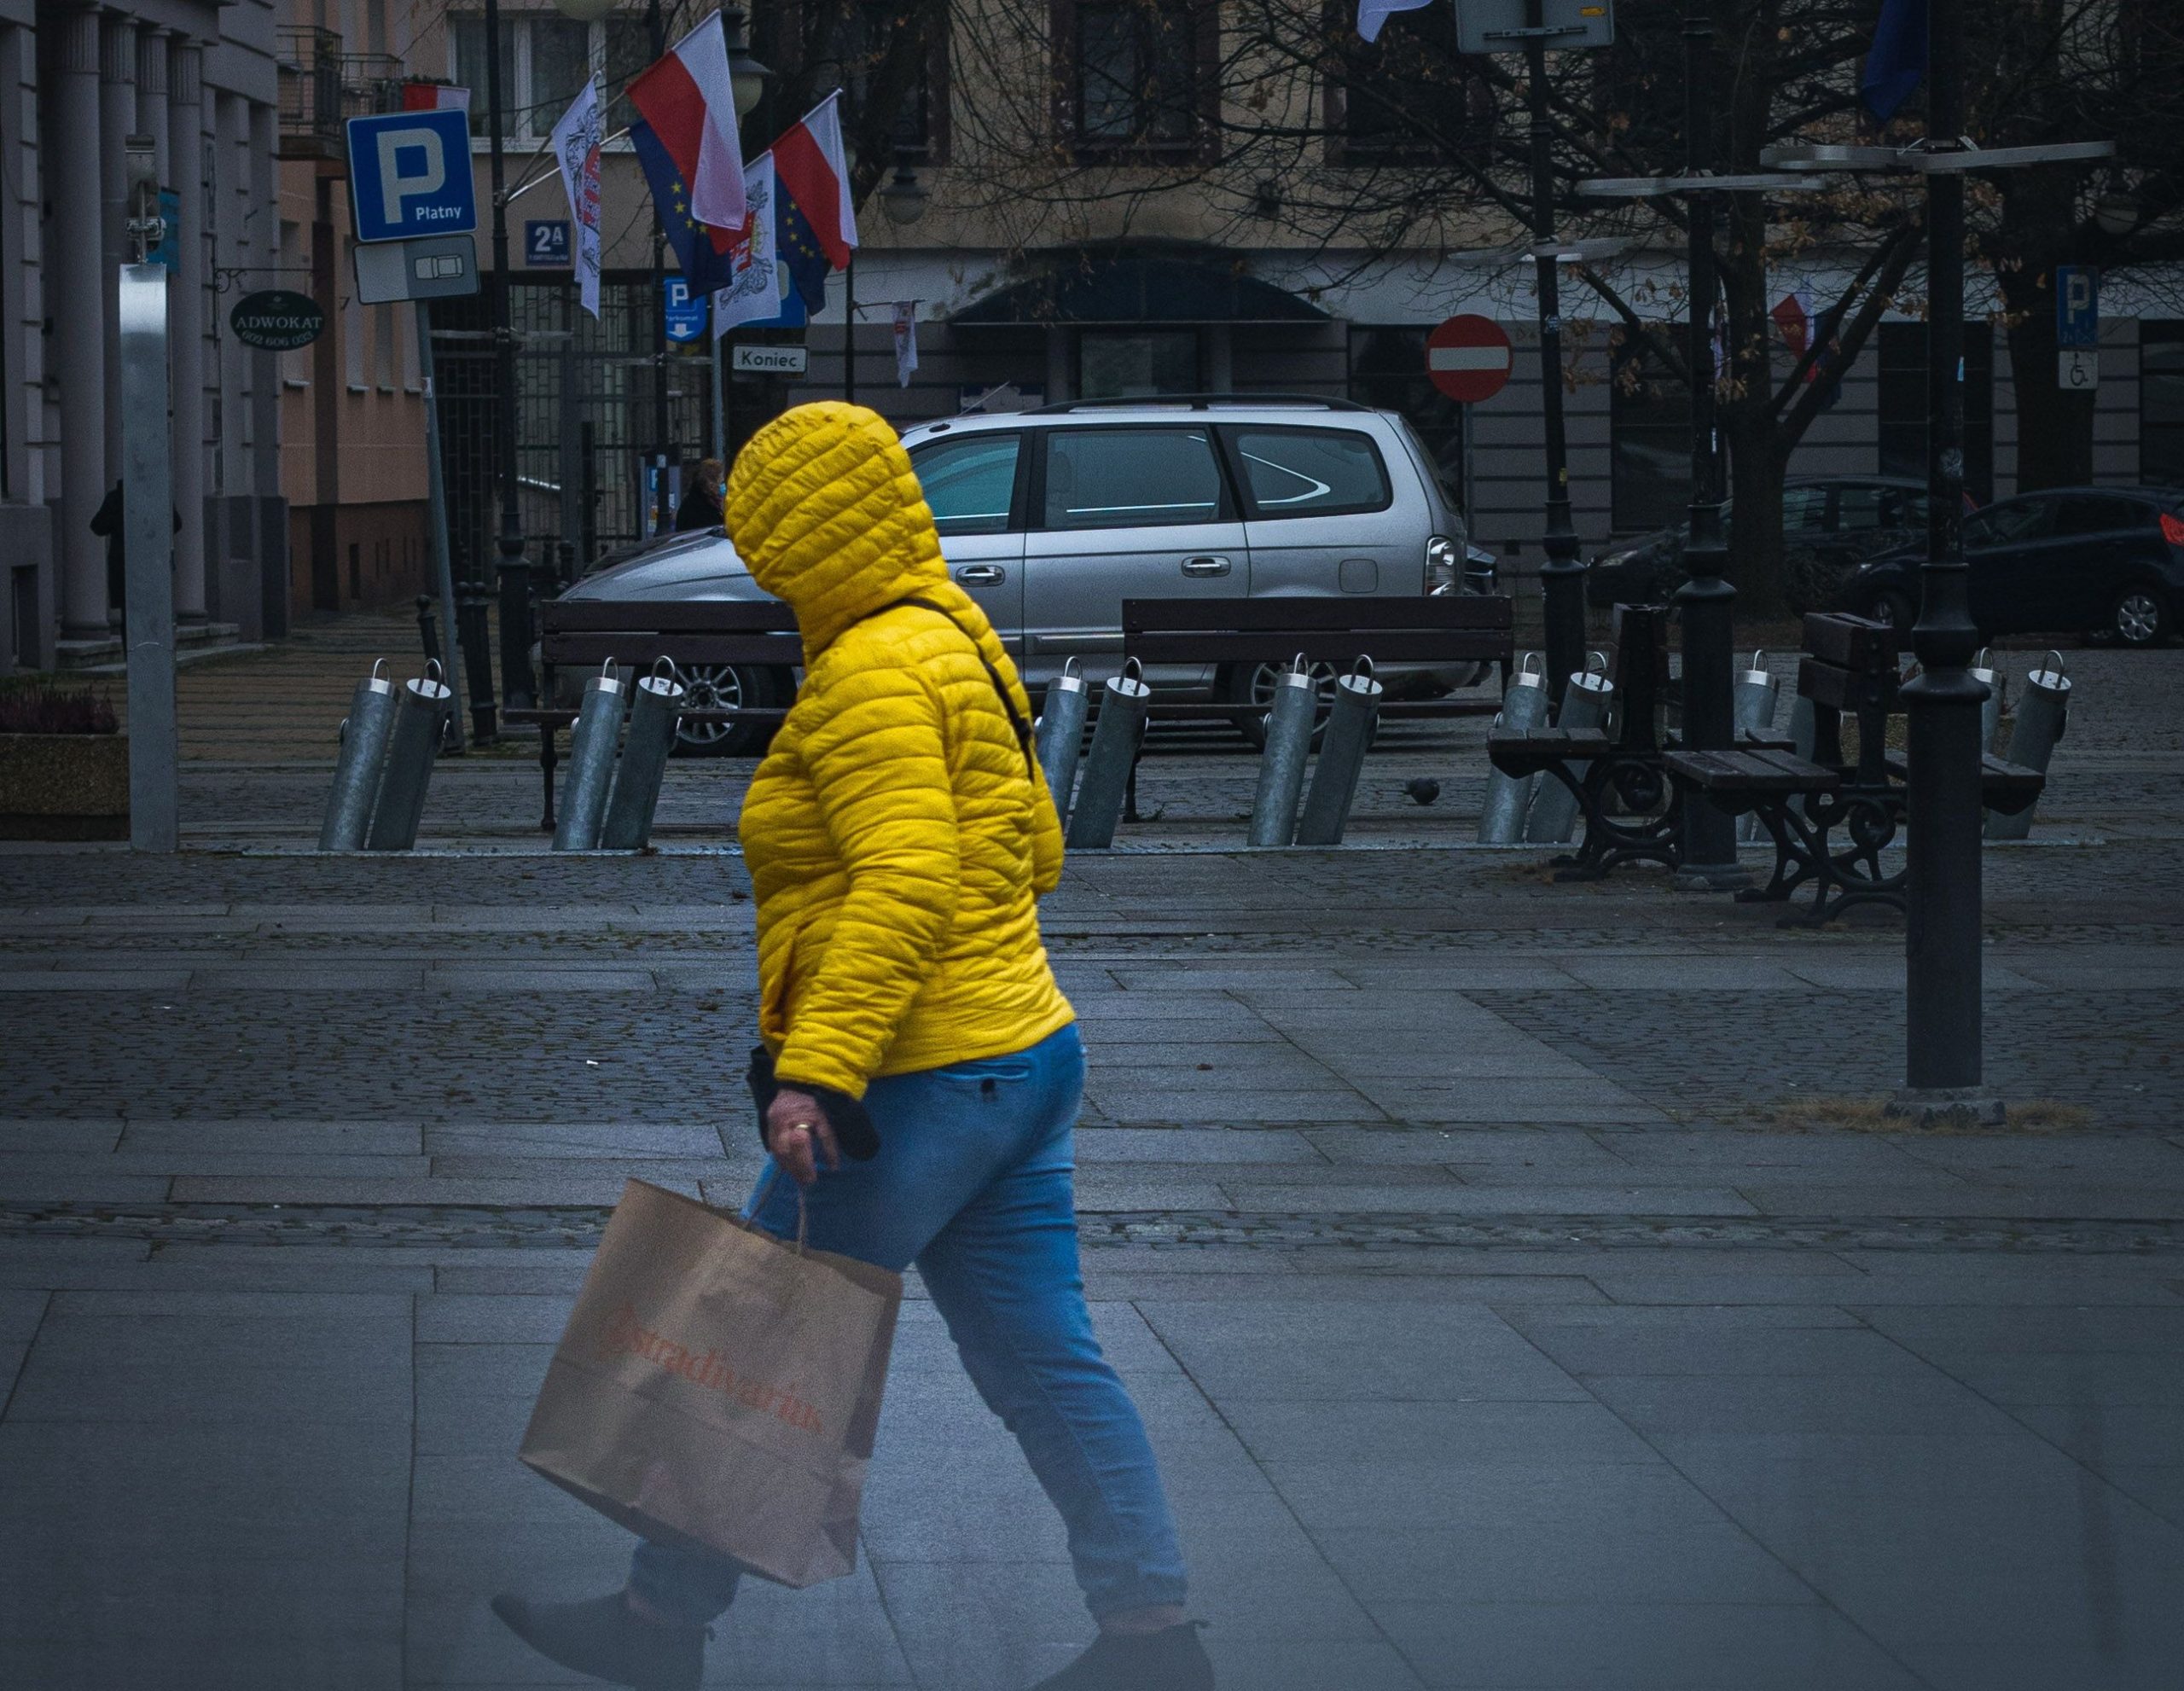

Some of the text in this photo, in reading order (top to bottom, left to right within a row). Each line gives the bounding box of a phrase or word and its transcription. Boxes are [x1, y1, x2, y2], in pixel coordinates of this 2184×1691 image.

[376, 128, 446, 224] P
[671, 283, 689, 307] P
[2067, 274, 2089, 324] P
[235, 317, 322, 328] ADWOKAT
[241, 330, 264, 345] 602
[741, 351, 797, 367] Koniec
